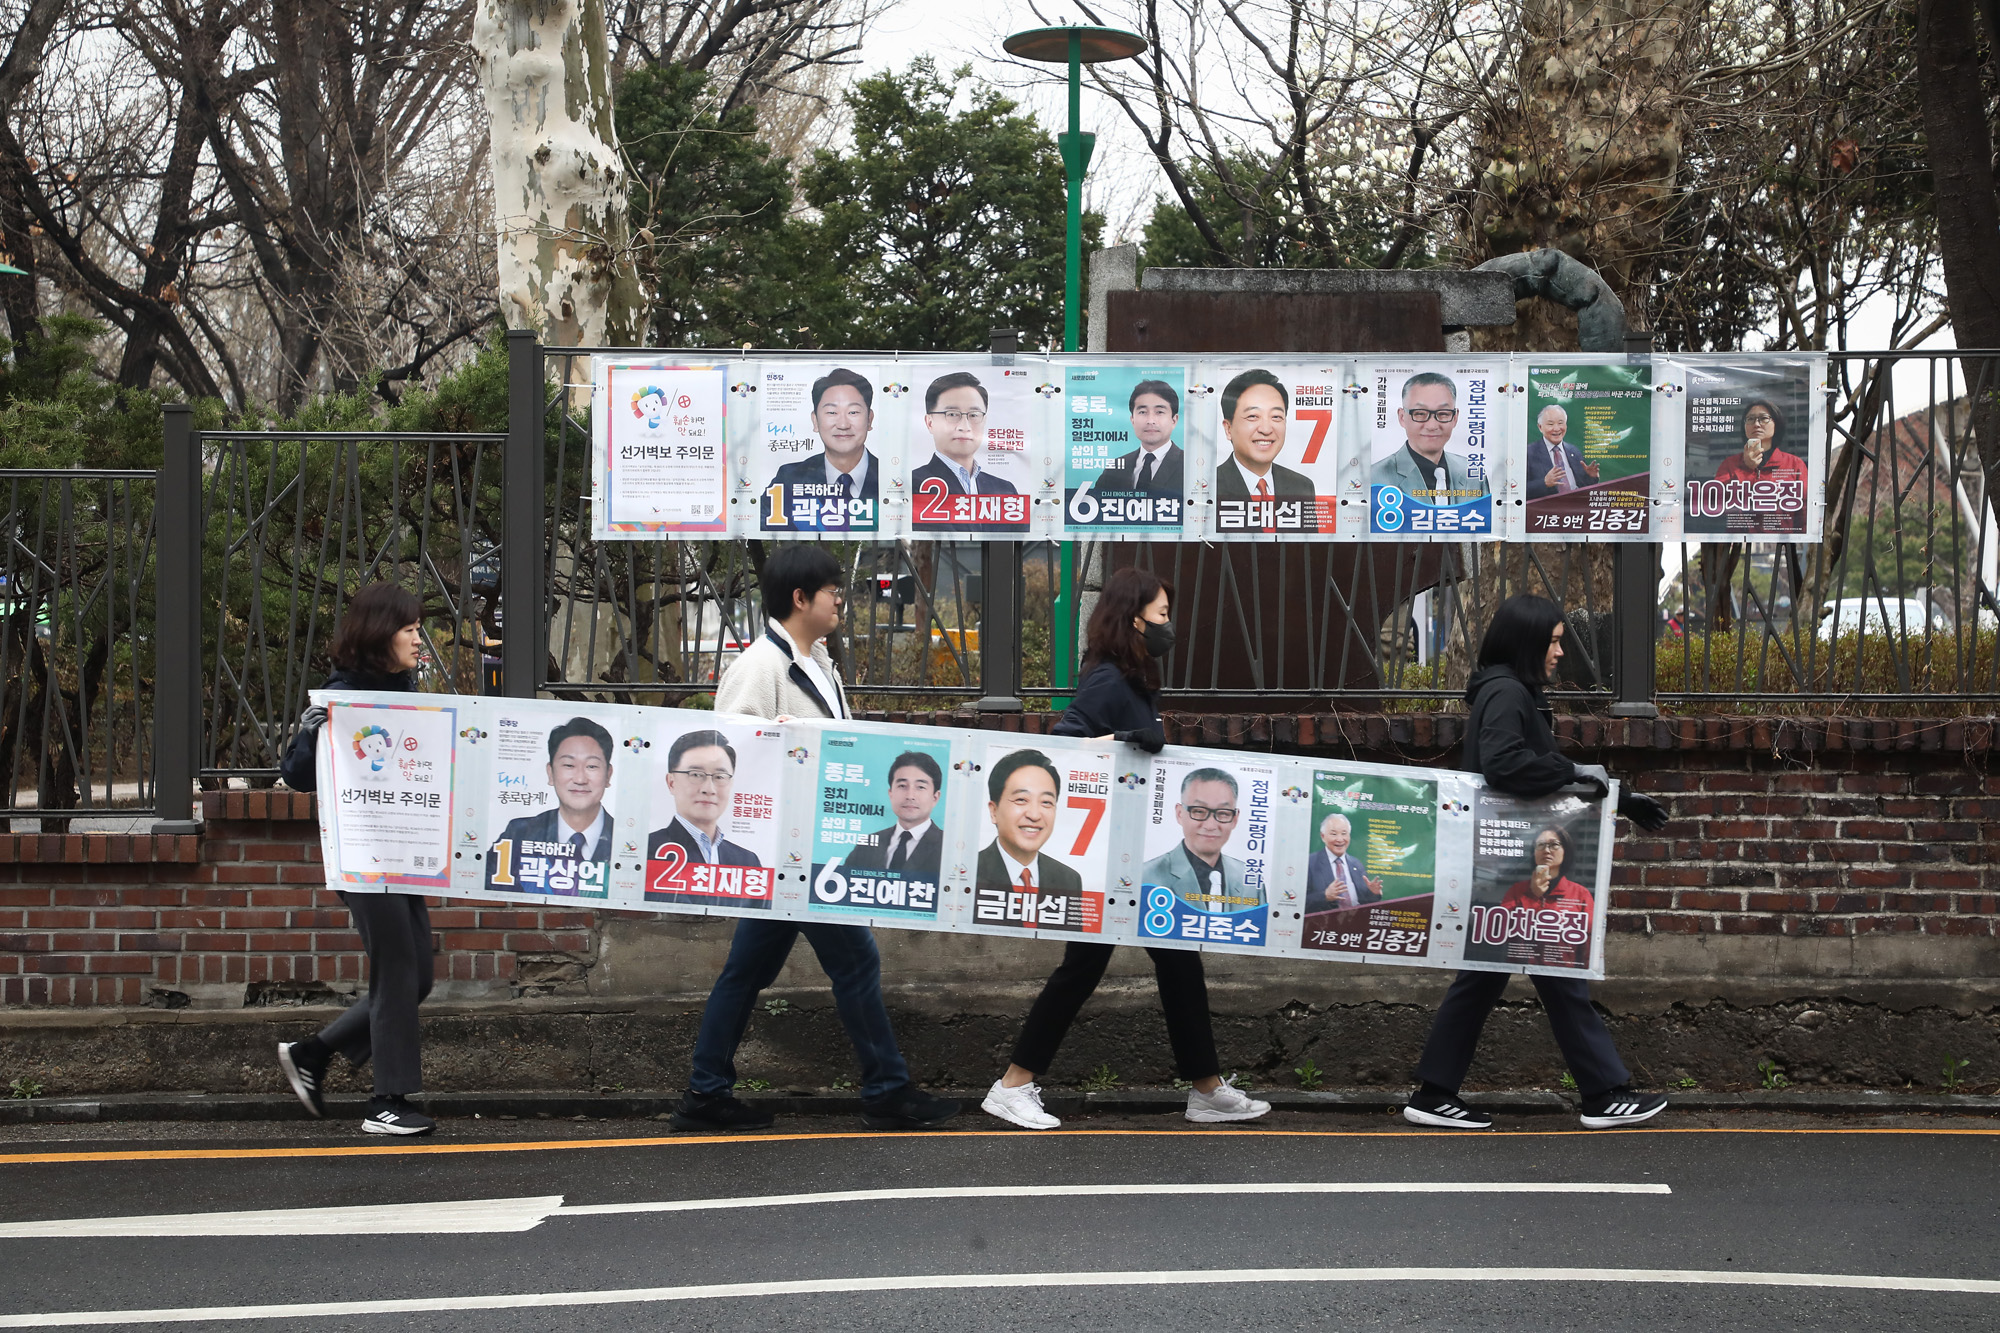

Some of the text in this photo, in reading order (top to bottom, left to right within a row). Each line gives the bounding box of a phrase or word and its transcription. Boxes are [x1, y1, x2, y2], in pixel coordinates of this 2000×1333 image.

[1295, 385, 1333, 395] 금태섭은
[1625, 390, 1643, 398] 주인공
[1071, 395, 1113, 415] 종로,
[1295, 396, 1333, 406] 바꿉니다
[1377, 376, 1387, 429] 가락특권폐지당
[1071, 418, 1094, 429] 정치
[1692, 415, 1734, 424] 민중권력쟁취!
[678, 427, 706, 437] 안 돼요!
[766, 422, 795, 438] 다시,
[988, 428, 1024, 439] 중단없는
[1071, 431, 1128, 442] 일번지에서
[1295, 409, 1332, 464] 7
[1467, 379, 1487, 480] 정보도령이 왔다
[620, 445, 715, 460] 선거벽보 주의문
[768, 438, 814, 452] 종로답게!
[987, 440, 1024, 451] 종로발전
[1071, 445, 1108, 457] 삶의 질
[1071, 458, 1125, 470] 일번지로!!
[792, 483, 844, 496] 듬직하다!
[766, 483, 874, 526] 1 곽상언
[919, 476, 1025, 521] 2 최재형
[1069, 481, 1180, 523] 6 진예찬
[1687, 480, 1804, 517] 10 차은정
[1219, 500, 1301, 528] 금태섭
[1376, 485, 1485, 532] 8 김준수
[1534, 509, 1647, 531] 기호 9번 김종갑
[499, 719, 518, 727] 민주당
[402, 771, 413, 781] 안
[497, 771, 528, 790] 다시,
[824, 762, 871, 787] 종로,
[1069, 770, 1109, 783] 금태섭은
[824, 787, 848, 800] 정치
[1067, 782, 1108, 795] 바꿉니다
[1152, 768, 1166, 825] 가락특권폐지당
[341, 788, 441, 808] 선거벽보 주의문
[497, 790, 548, 806] 종로답게!
[733, 792, 773, 806] 중단없는
[732, 806, 772, 819] 종로발전
[823, 801, 885, 816] 일번지에서
[821, 816, 862, 832] 삶의 질
[1067, 796, 1107, 856] 7
[820, 830, 879, 847] 일번지로!!
[1244, 779, 1269, 889] 정보도령이 왔다
[521, 840, 576, 857] 듬직하다!
[491, 838, 605, 892] 1 곽상언
[653, 842, 769, 897] 2 최재형
[814, 856, 936, 909] 6 진예찬
[976, 889, 1067, 925] 금태섭
[1144, 885, 1176, 937] 8
[1181, 914, 1260, 942] 김준수
[1471, 905, 1589, 945] 10 차은정
[1311, 928, 1427, 953] 기호 9번 김종갑
